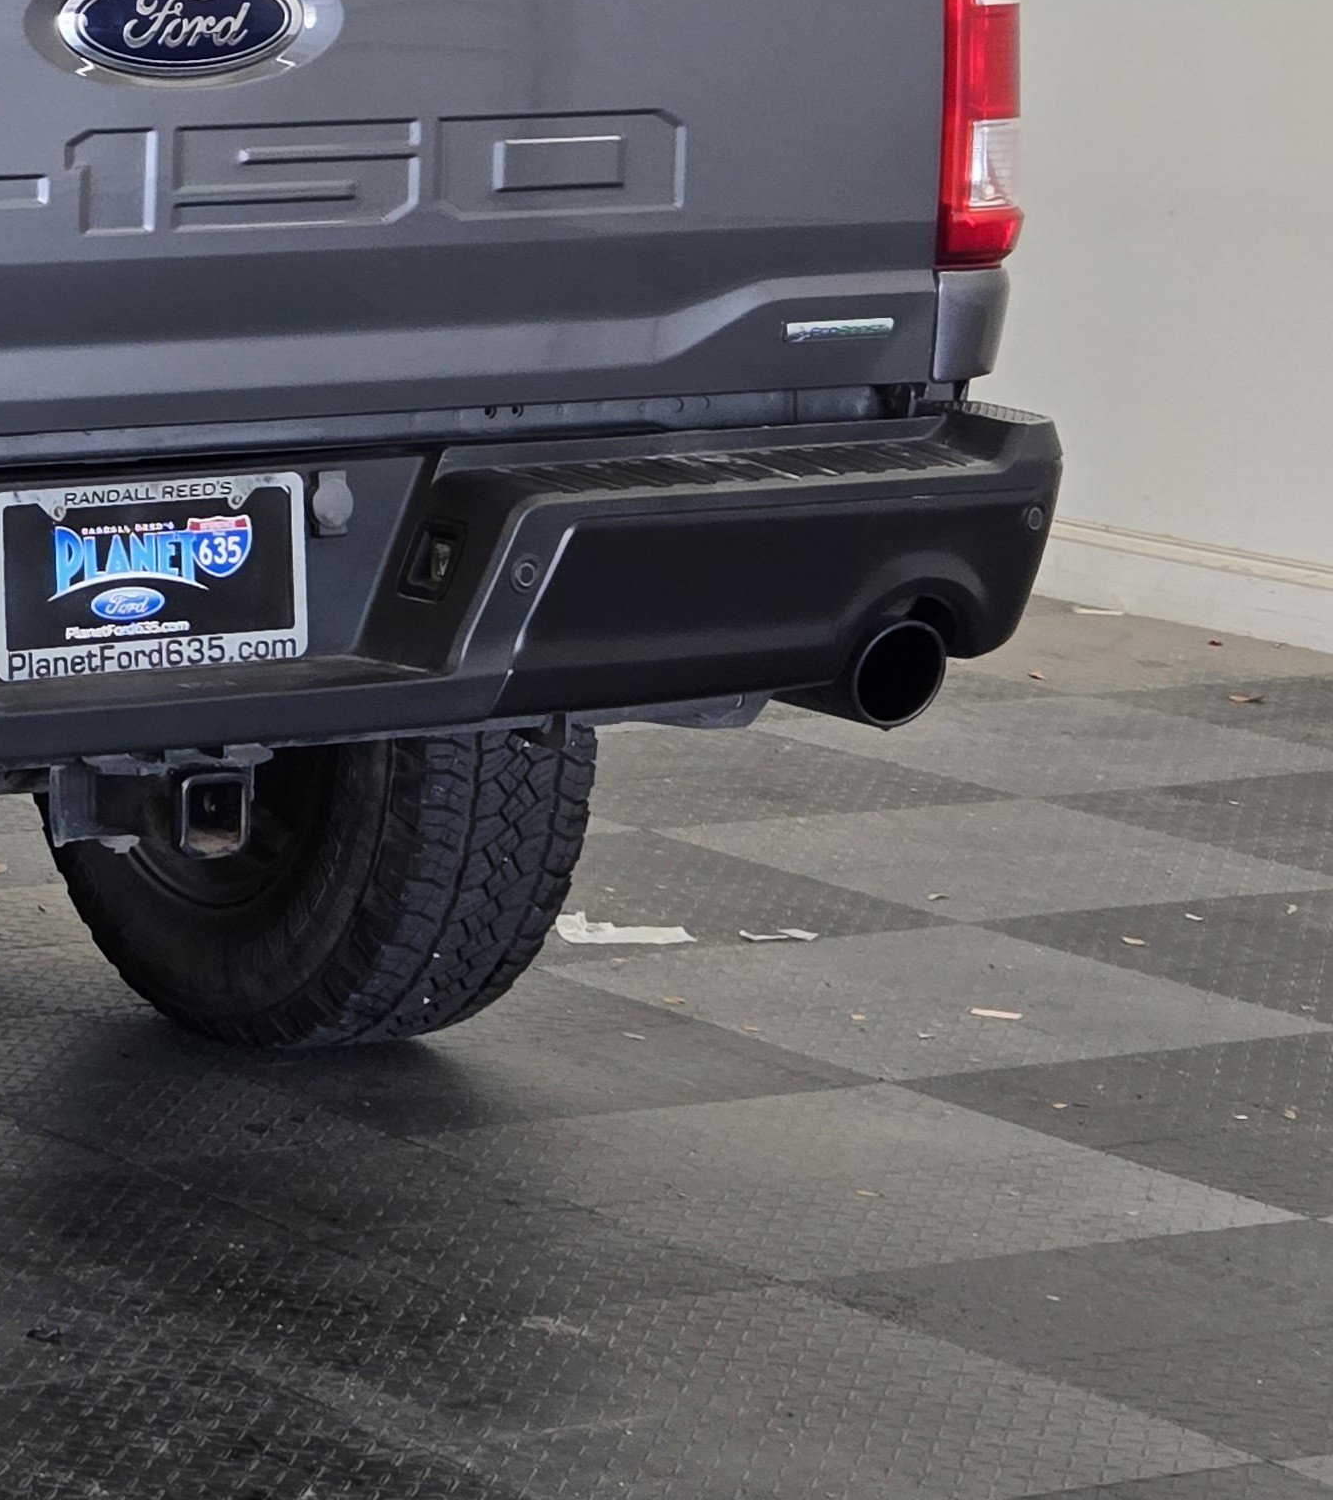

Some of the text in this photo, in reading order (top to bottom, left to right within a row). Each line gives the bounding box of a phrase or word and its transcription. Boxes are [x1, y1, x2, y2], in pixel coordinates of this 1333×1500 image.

[64, 481, 233, 507] RANDALL REED'S
[54, 526, 242, 596] PLANET 635
[104, 593, 149, 615] Ford
[8, 636, 296, 681] PlanetFord635.com
